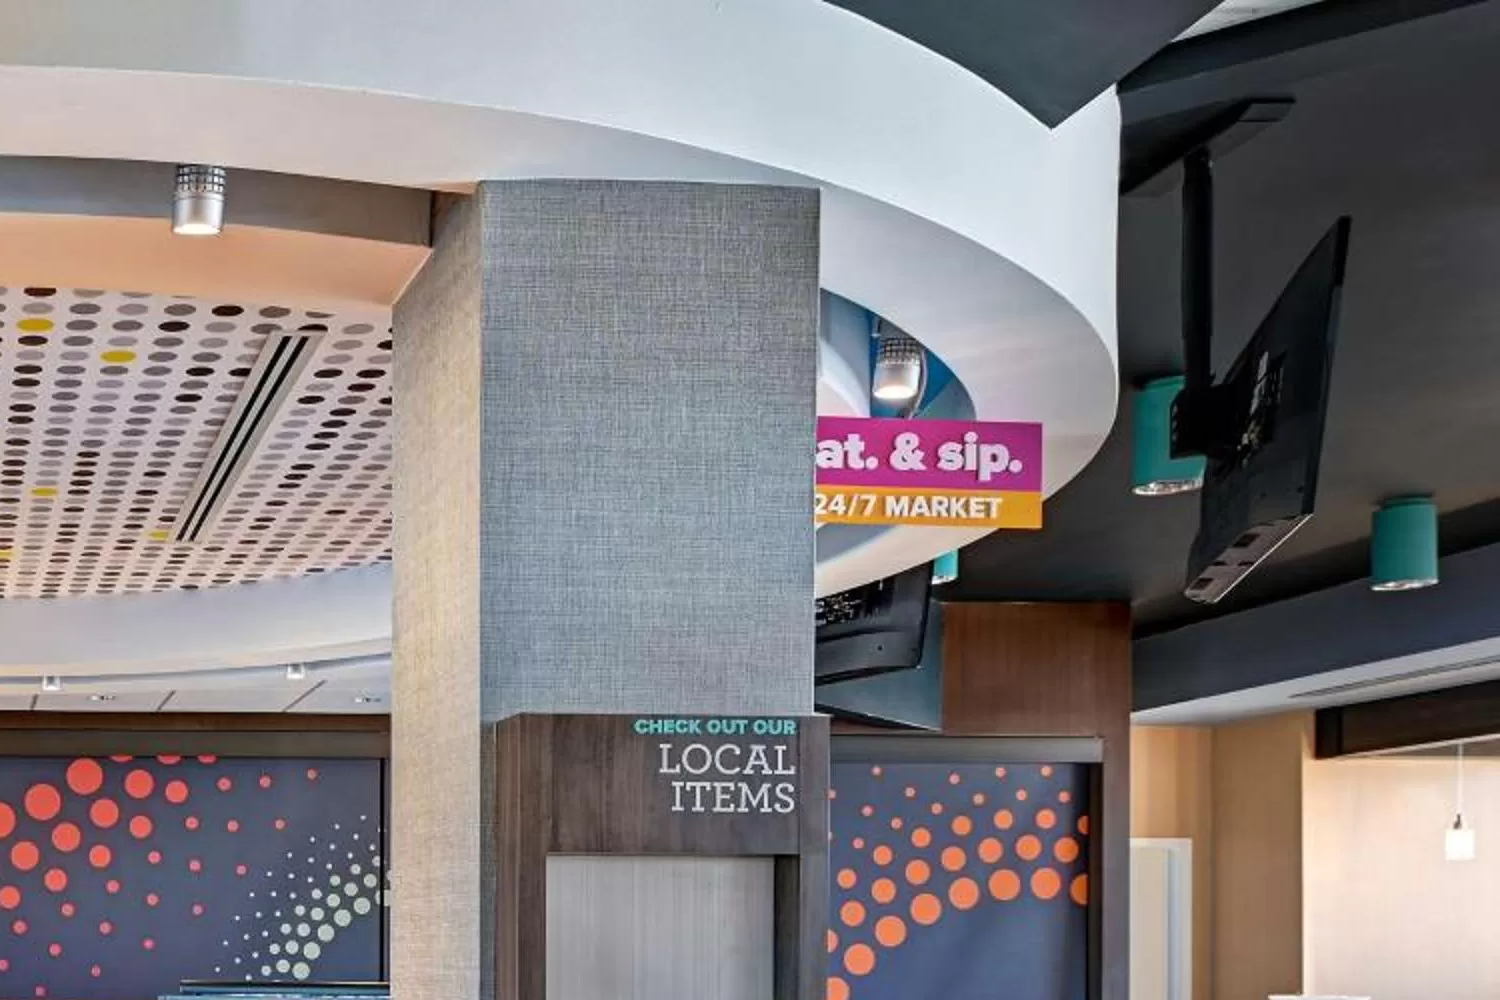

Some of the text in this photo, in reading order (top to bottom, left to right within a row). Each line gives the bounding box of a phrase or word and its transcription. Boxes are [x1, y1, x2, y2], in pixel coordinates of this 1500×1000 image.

[890, 432, 927, 471] &
[937, 431, 1023, 482] sip.
[814, 493, 1004, 519] 24/7 MARKET
[634, 719, 797, 735] CHECK OUT OUR
[659, 743, 797, 775] LOCAL
[671, 781, 796, 814] ITEMS
